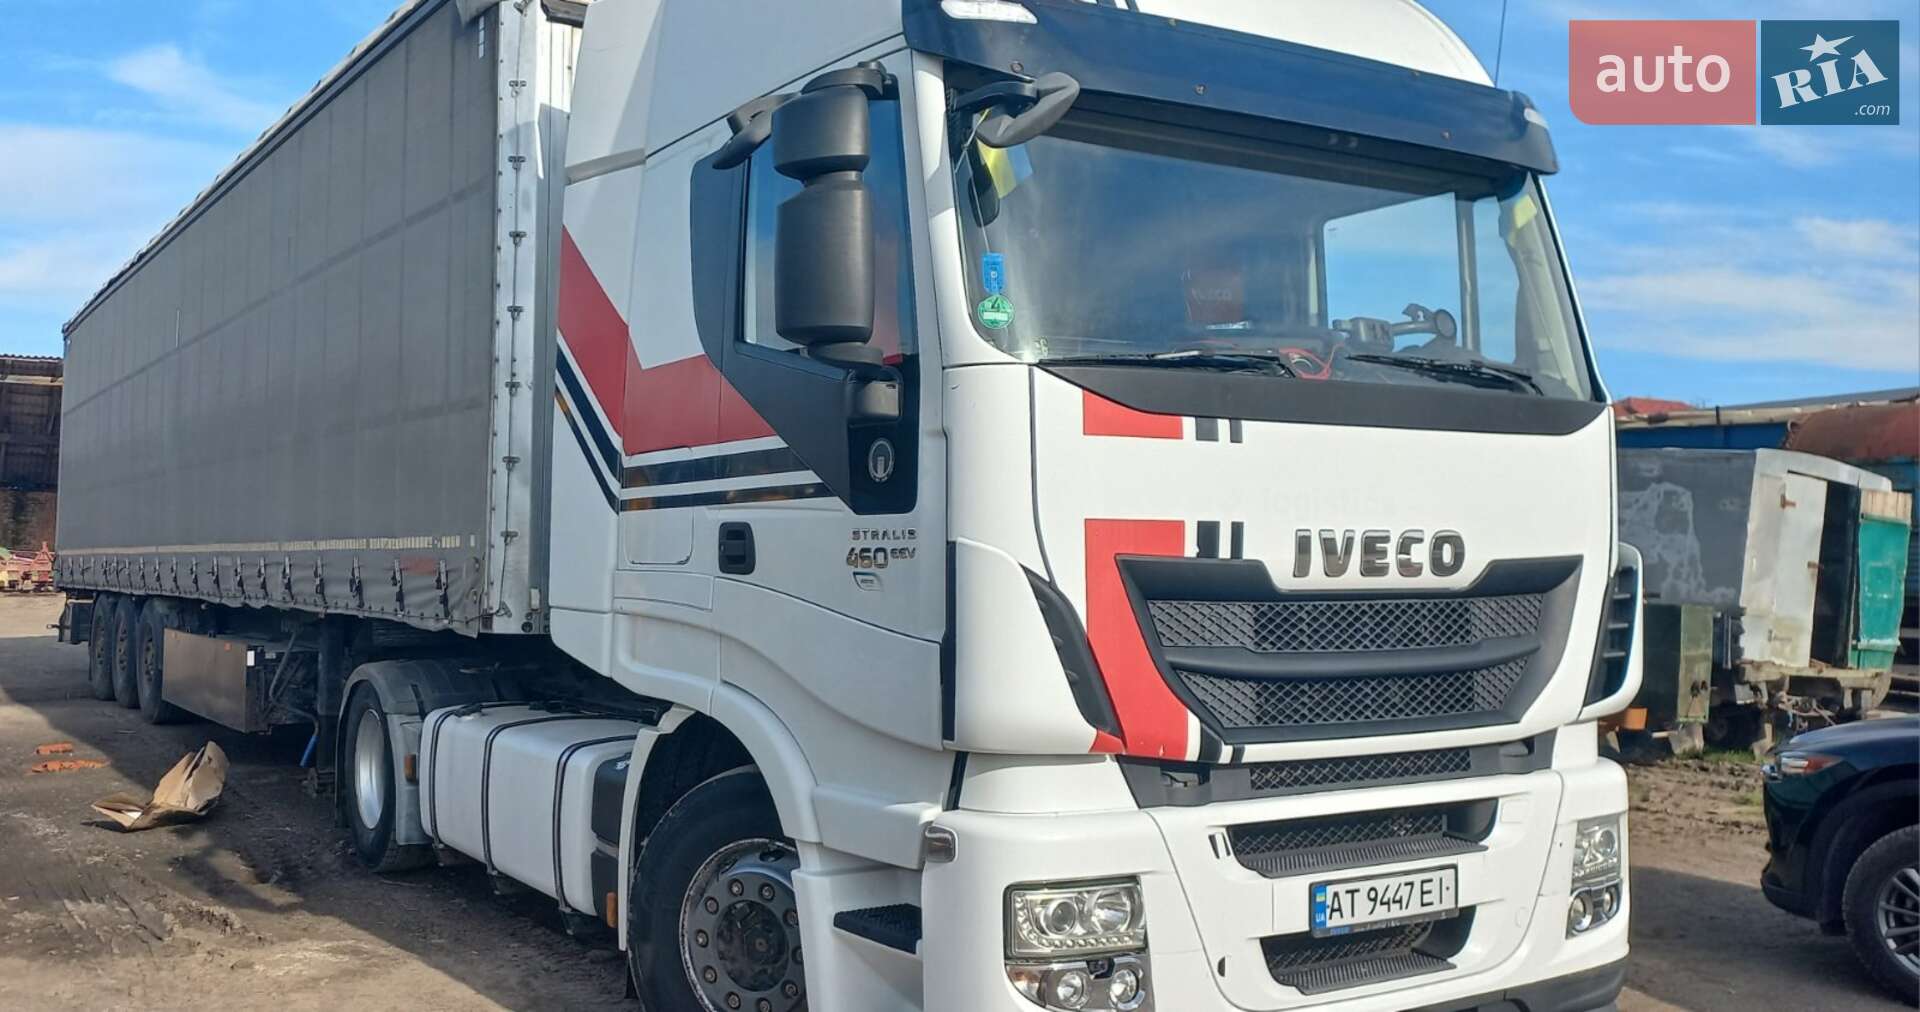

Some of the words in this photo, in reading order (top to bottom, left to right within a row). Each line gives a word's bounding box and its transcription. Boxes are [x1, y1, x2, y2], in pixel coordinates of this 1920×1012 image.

[852, 528, 918, 541] STRALIS
[846, 546, 889, 569] 460
[890, 547, 916, 560] EEV
[1292, 528, 1466, 578] IVECO
[1328, 888, 1361, 920] AT
[1367, 881, 1415, 916] 9447
[1420, 877, 1443, 908] EI
[1315, 911, 1325, 923] UA
